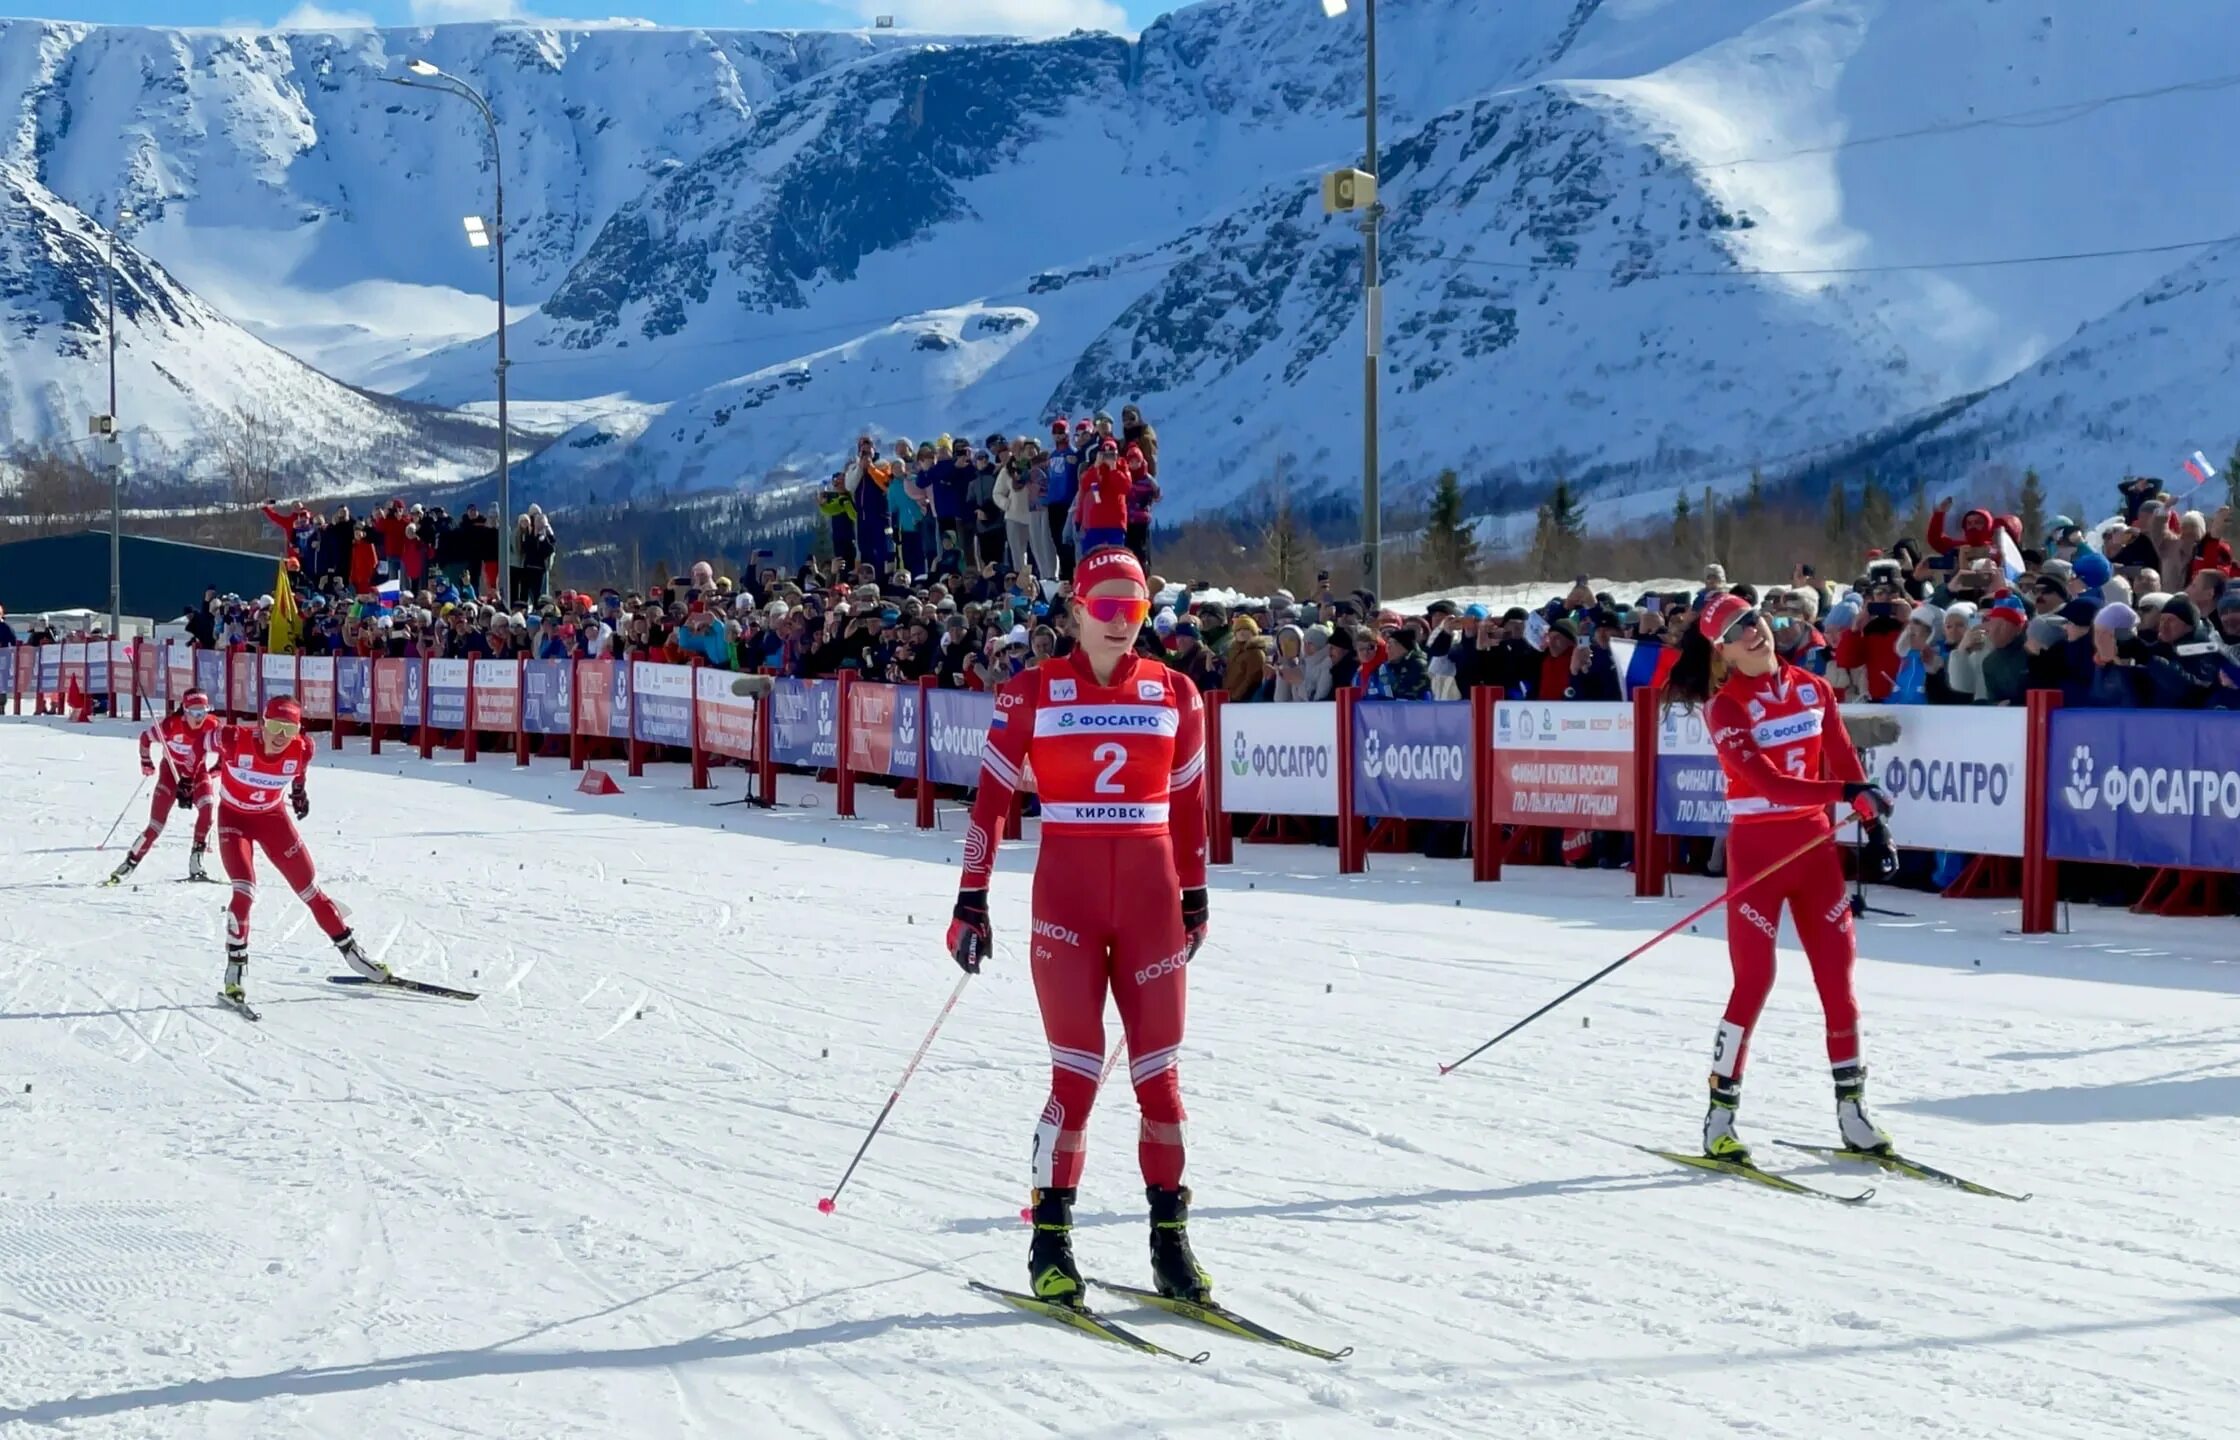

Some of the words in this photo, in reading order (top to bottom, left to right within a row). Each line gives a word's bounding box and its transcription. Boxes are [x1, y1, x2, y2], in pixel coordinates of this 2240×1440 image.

[1080, 714, 1159, 727] ФОСАГРО
[944, 725, 985, 758] ФОСАГР
[1093, 742, 1127, 794] 2
[1253, 744, 1328, 779] ФОСАГРО
[1385, 744, 1463, 781] ФОСАГРО
[1511, 763, 1546, 785] ФИНАЛ
[1547, 763, 1578, 785] КУБКА
[1579, 764, 1618, 787] РОССИИ
[1786, 747, 1806, 779] 5
[249, 790, 266, 802] 4
[1677, 769, 1714, 792] ФИНАЛ
[1886, 756, 2009, 806] ФОСАГРО
[2103, 765, 2240, 819] ФОСАГРО
[1076, 807, 1145, 818] КИРОВСК
[1513, 791, 1528, 812] ПО
[1677, 800, 1694, 822] ПО
[1693, 800, 1733, 824] ЛЫЖН
[1739, 902, 1777, 938] BOSCO
[1135, 950, 1187, 986] BOSCO
[1714, 1030, 1727, 1062] 5
